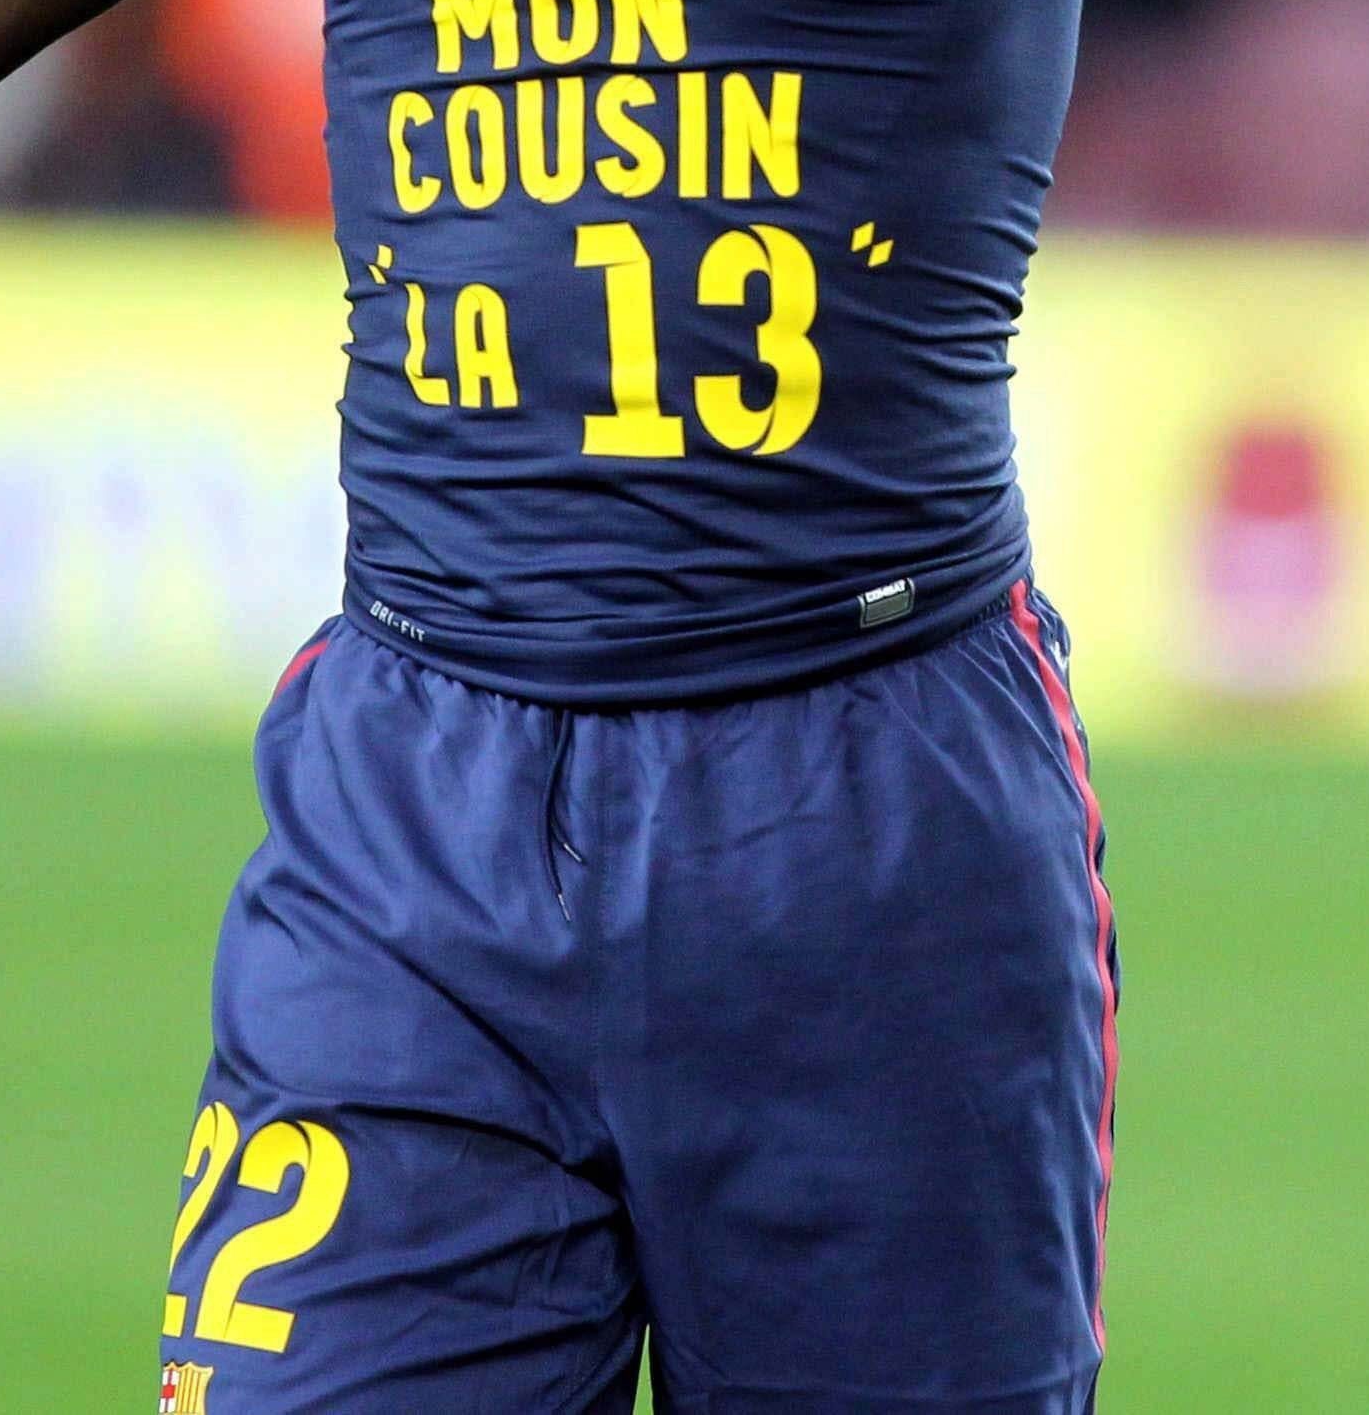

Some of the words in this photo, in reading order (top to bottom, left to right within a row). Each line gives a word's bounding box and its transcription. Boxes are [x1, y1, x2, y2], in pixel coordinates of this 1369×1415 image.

[387, 71, 802, 213] COUSIN
[370, 600, 425, 640] DRI-FIT
[162, 1101, 350, 1353] 22
